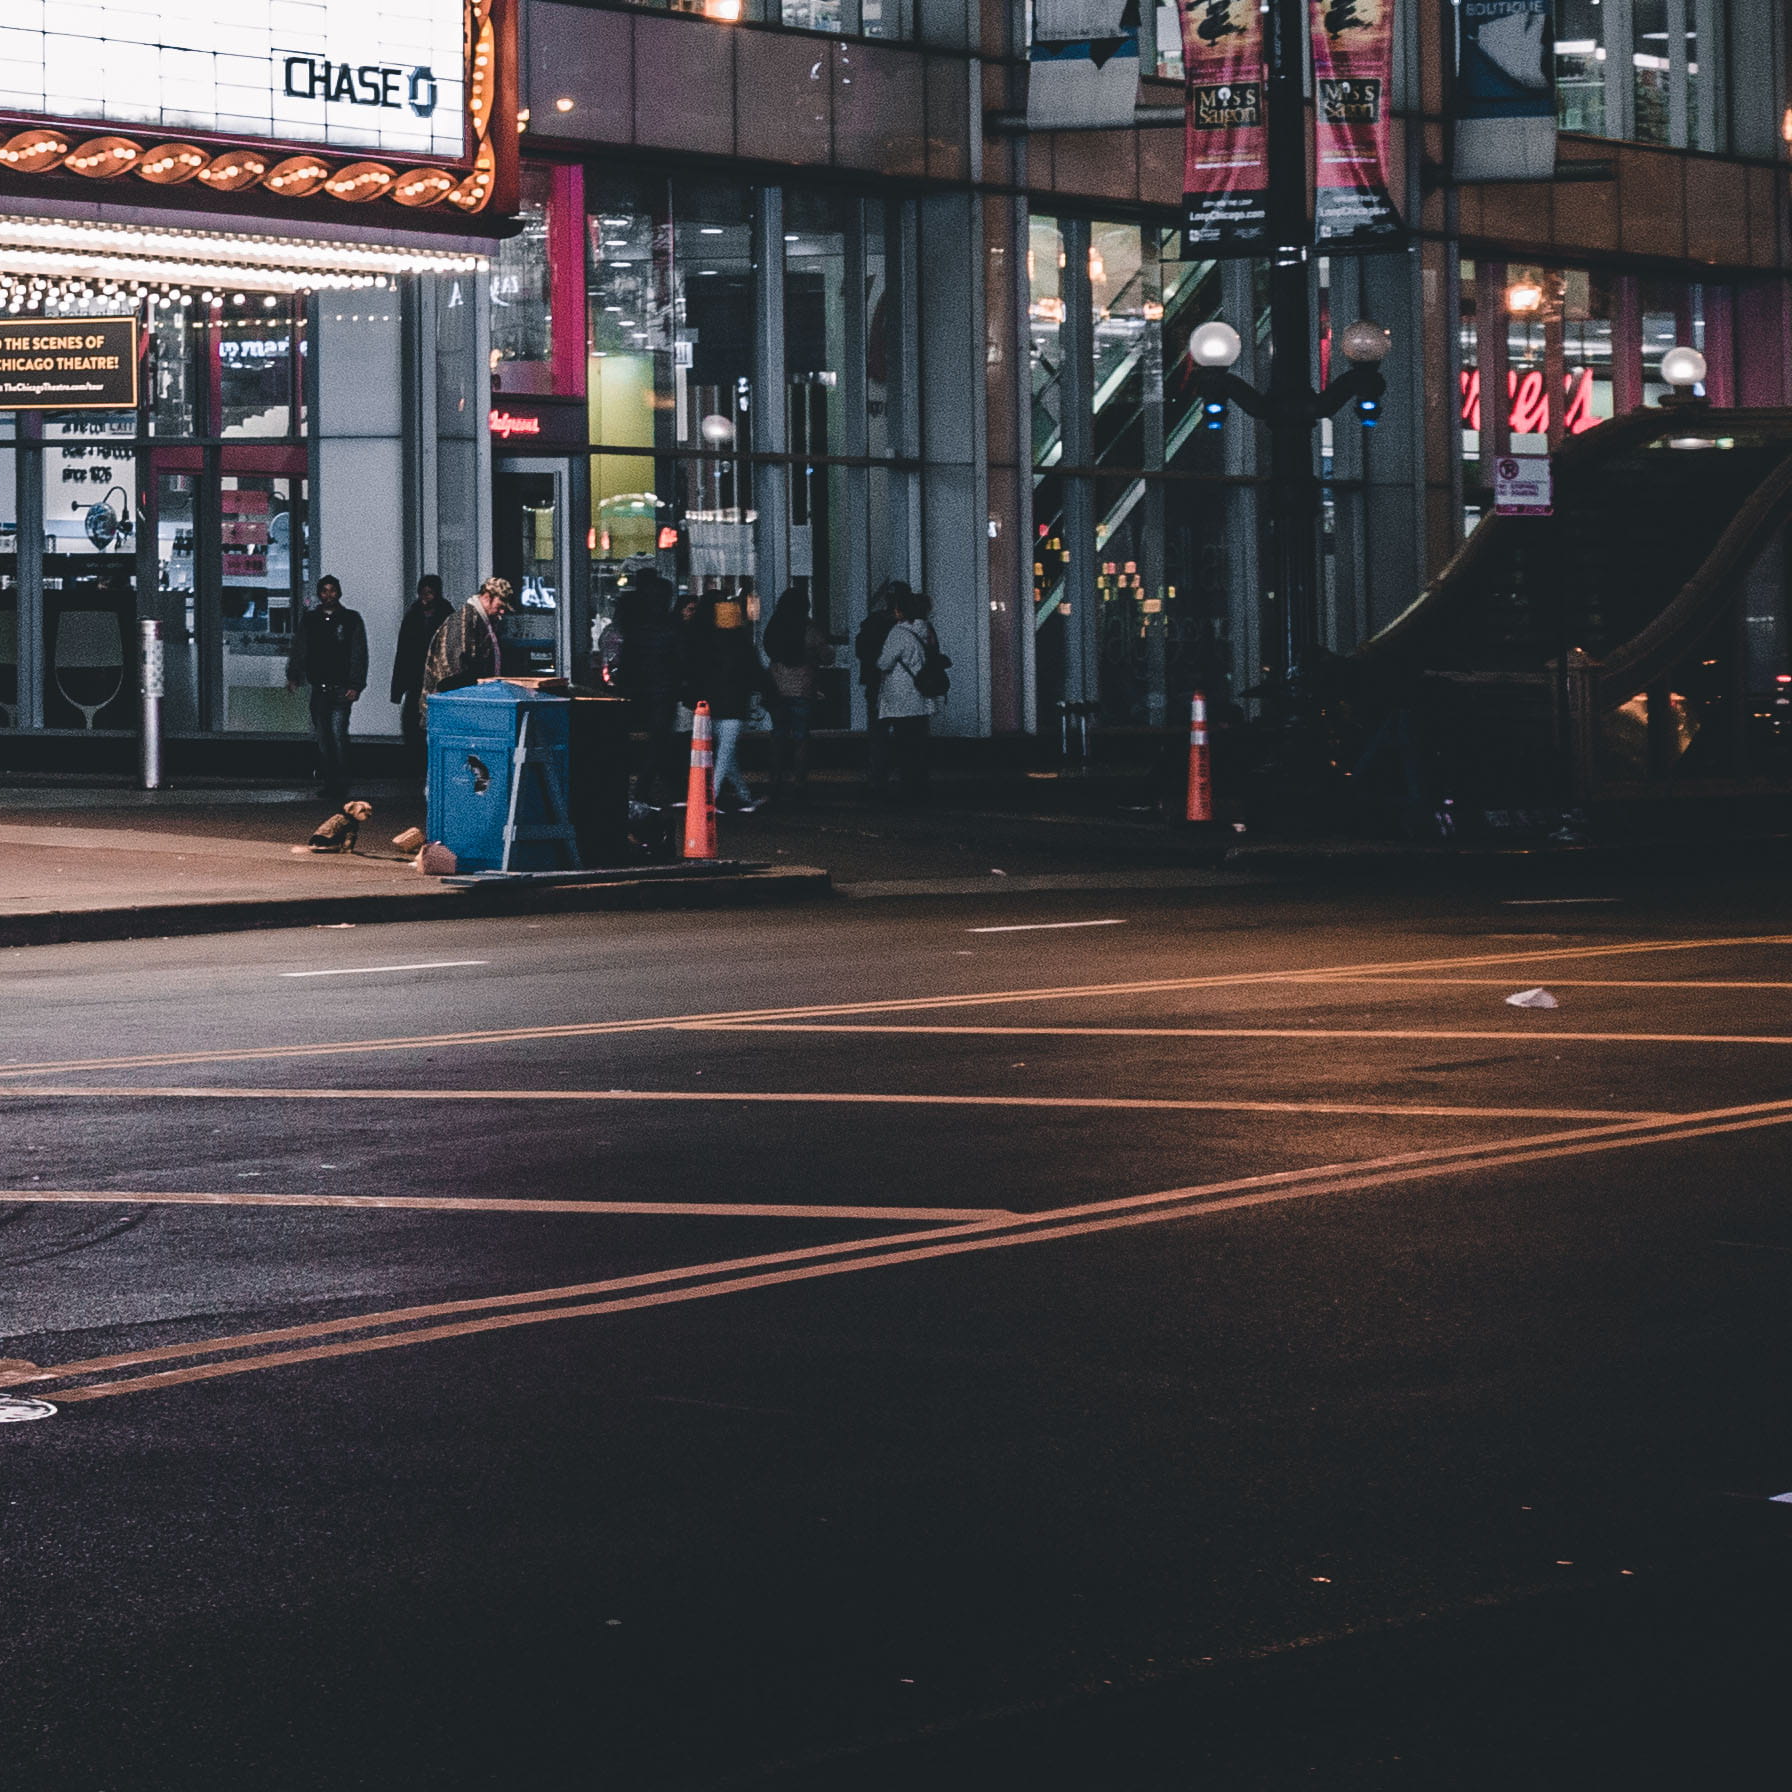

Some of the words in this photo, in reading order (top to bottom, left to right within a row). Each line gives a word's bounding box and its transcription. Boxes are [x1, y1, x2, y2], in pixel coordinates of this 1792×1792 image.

[1465, 0, 1544, 16] BOUTIQUE
[285, 57, 403, 108] CHASE
[1200, 107, 1257, 128] Saigon
[4, 337, 30, 350] THE
[32, 336, 83, 350] SCENES
[85, 335, 105, 349] OF
[57, 357, 119, 370] THEATRE!
